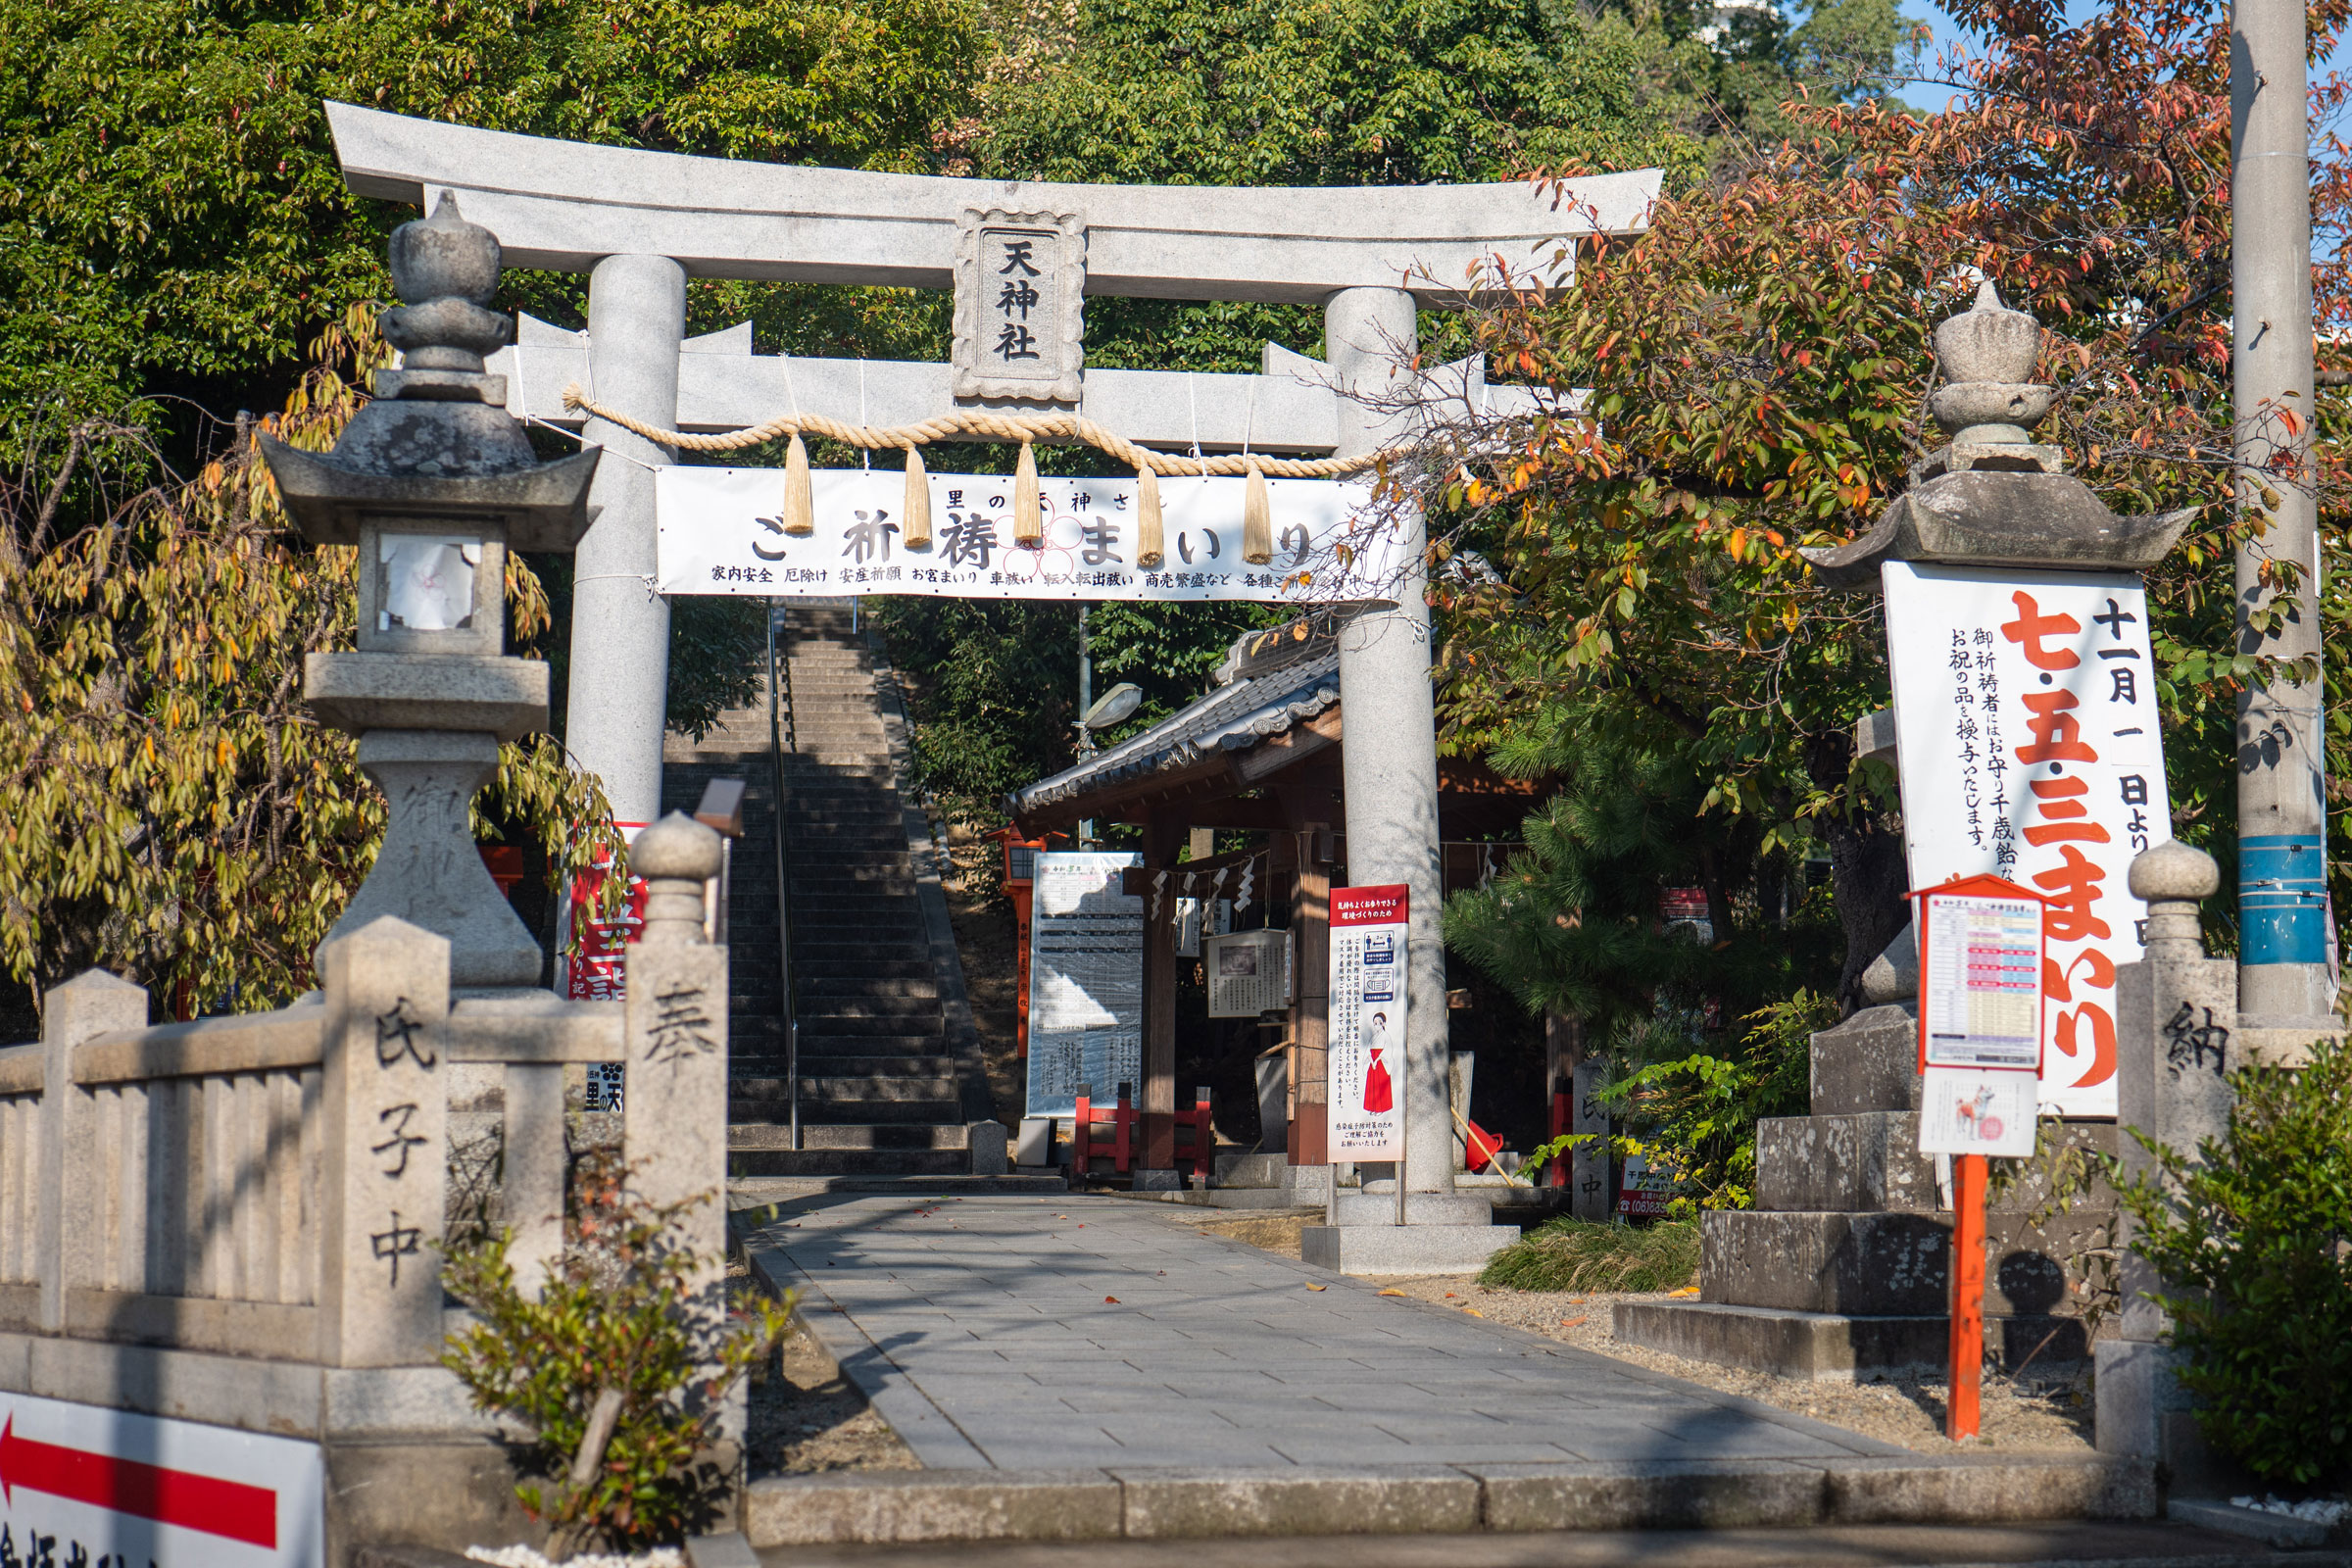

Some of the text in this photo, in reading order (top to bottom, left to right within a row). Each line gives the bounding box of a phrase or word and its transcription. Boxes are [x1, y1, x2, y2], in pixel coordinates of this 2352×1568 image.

[993, 240, 1041, 362] 天神社
[946, 489, 1168, 513] 里の神さ
[710, 565, 773, 583] 家内安全
[783, 567, 828, 584] 厄除け
[839, 565, 902, 583] 安産祈願
[911, 567, 977, 584] お宮まいり
[1145, 572, 1231, 588] 商売繁盛など
[1948, 628, 1987, 852] お祝の品を授与いたします。
[1341, 909, 1393, 920] 環境づくりのため
[644, 982, 718, 1080] 奉
[2163, 1000, 2230, 1083] 納
[584, 1082, 624, 1113] 里の天
[370, 996, 436, 1288] 氏子中
[1341, 1139, 1389, 1148] お願いいたします
